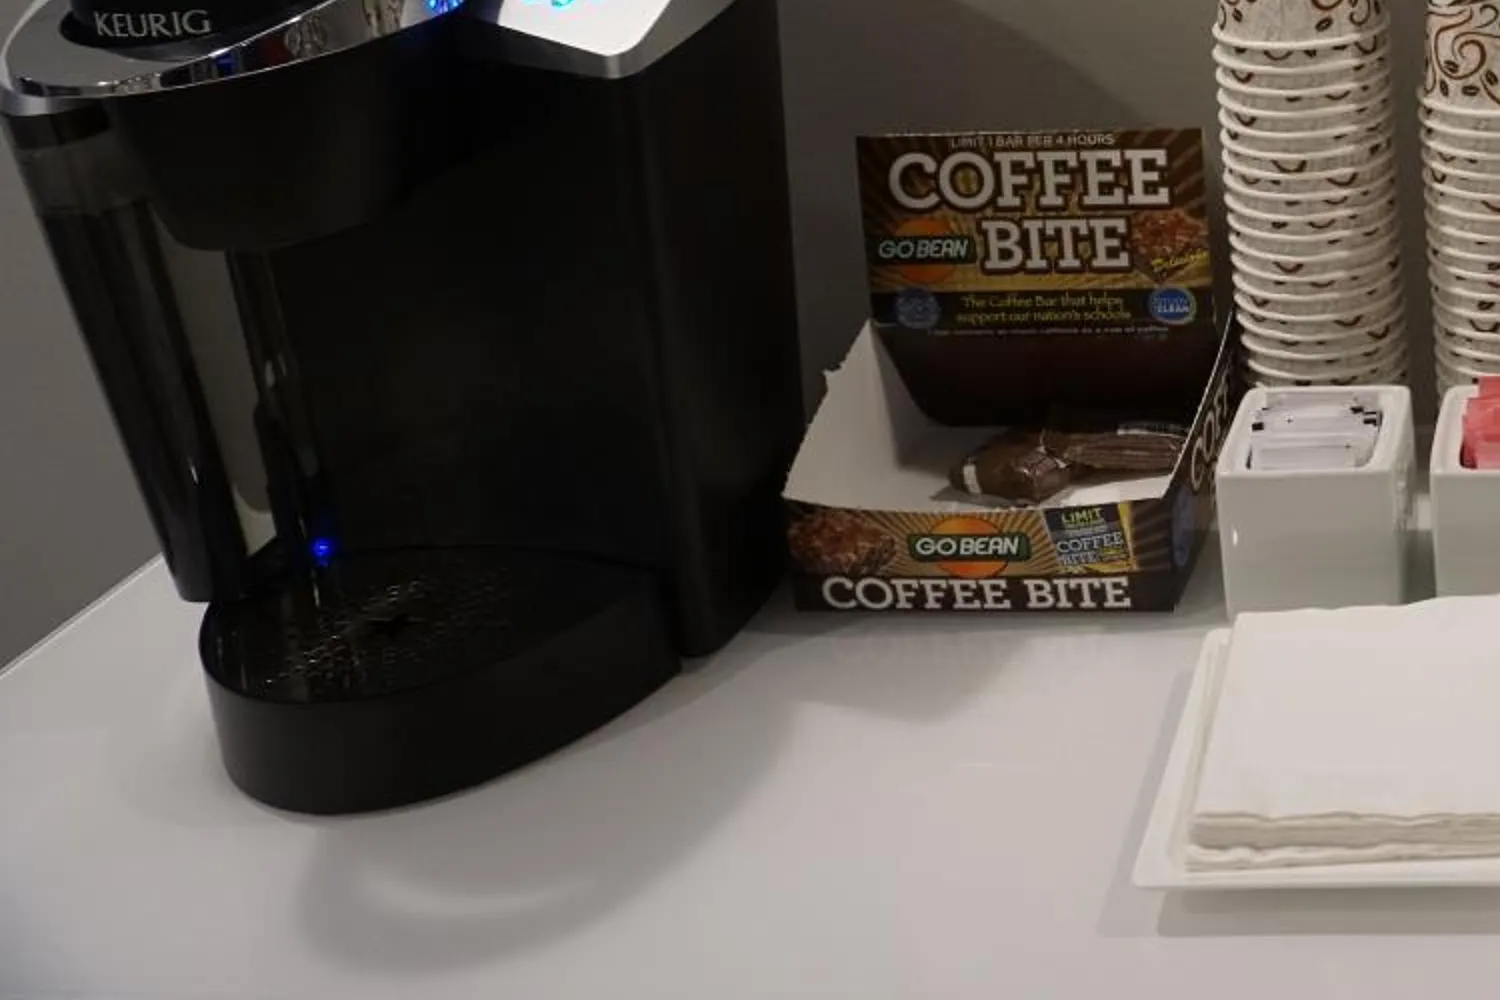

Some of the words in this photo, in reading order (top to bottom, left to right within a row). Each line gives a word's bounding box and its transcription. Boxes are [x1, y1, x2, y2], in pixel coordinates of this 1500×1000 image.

[94, 10, 211, 37] KEURIG
[950, 136, 987, 149] LIMIT
[996, 134, 1024, 148] BAR
[1067, 132, 1115, 146] HOURS
[888, 149, 1169, 209] COFFEE
[982, 218, 1130, 269] BITE
[1061, 507, 1104, 525] LIMIT
[822, 577, 1009, 609] COFFEE
[1026, 577, 1131, 608] BITE
